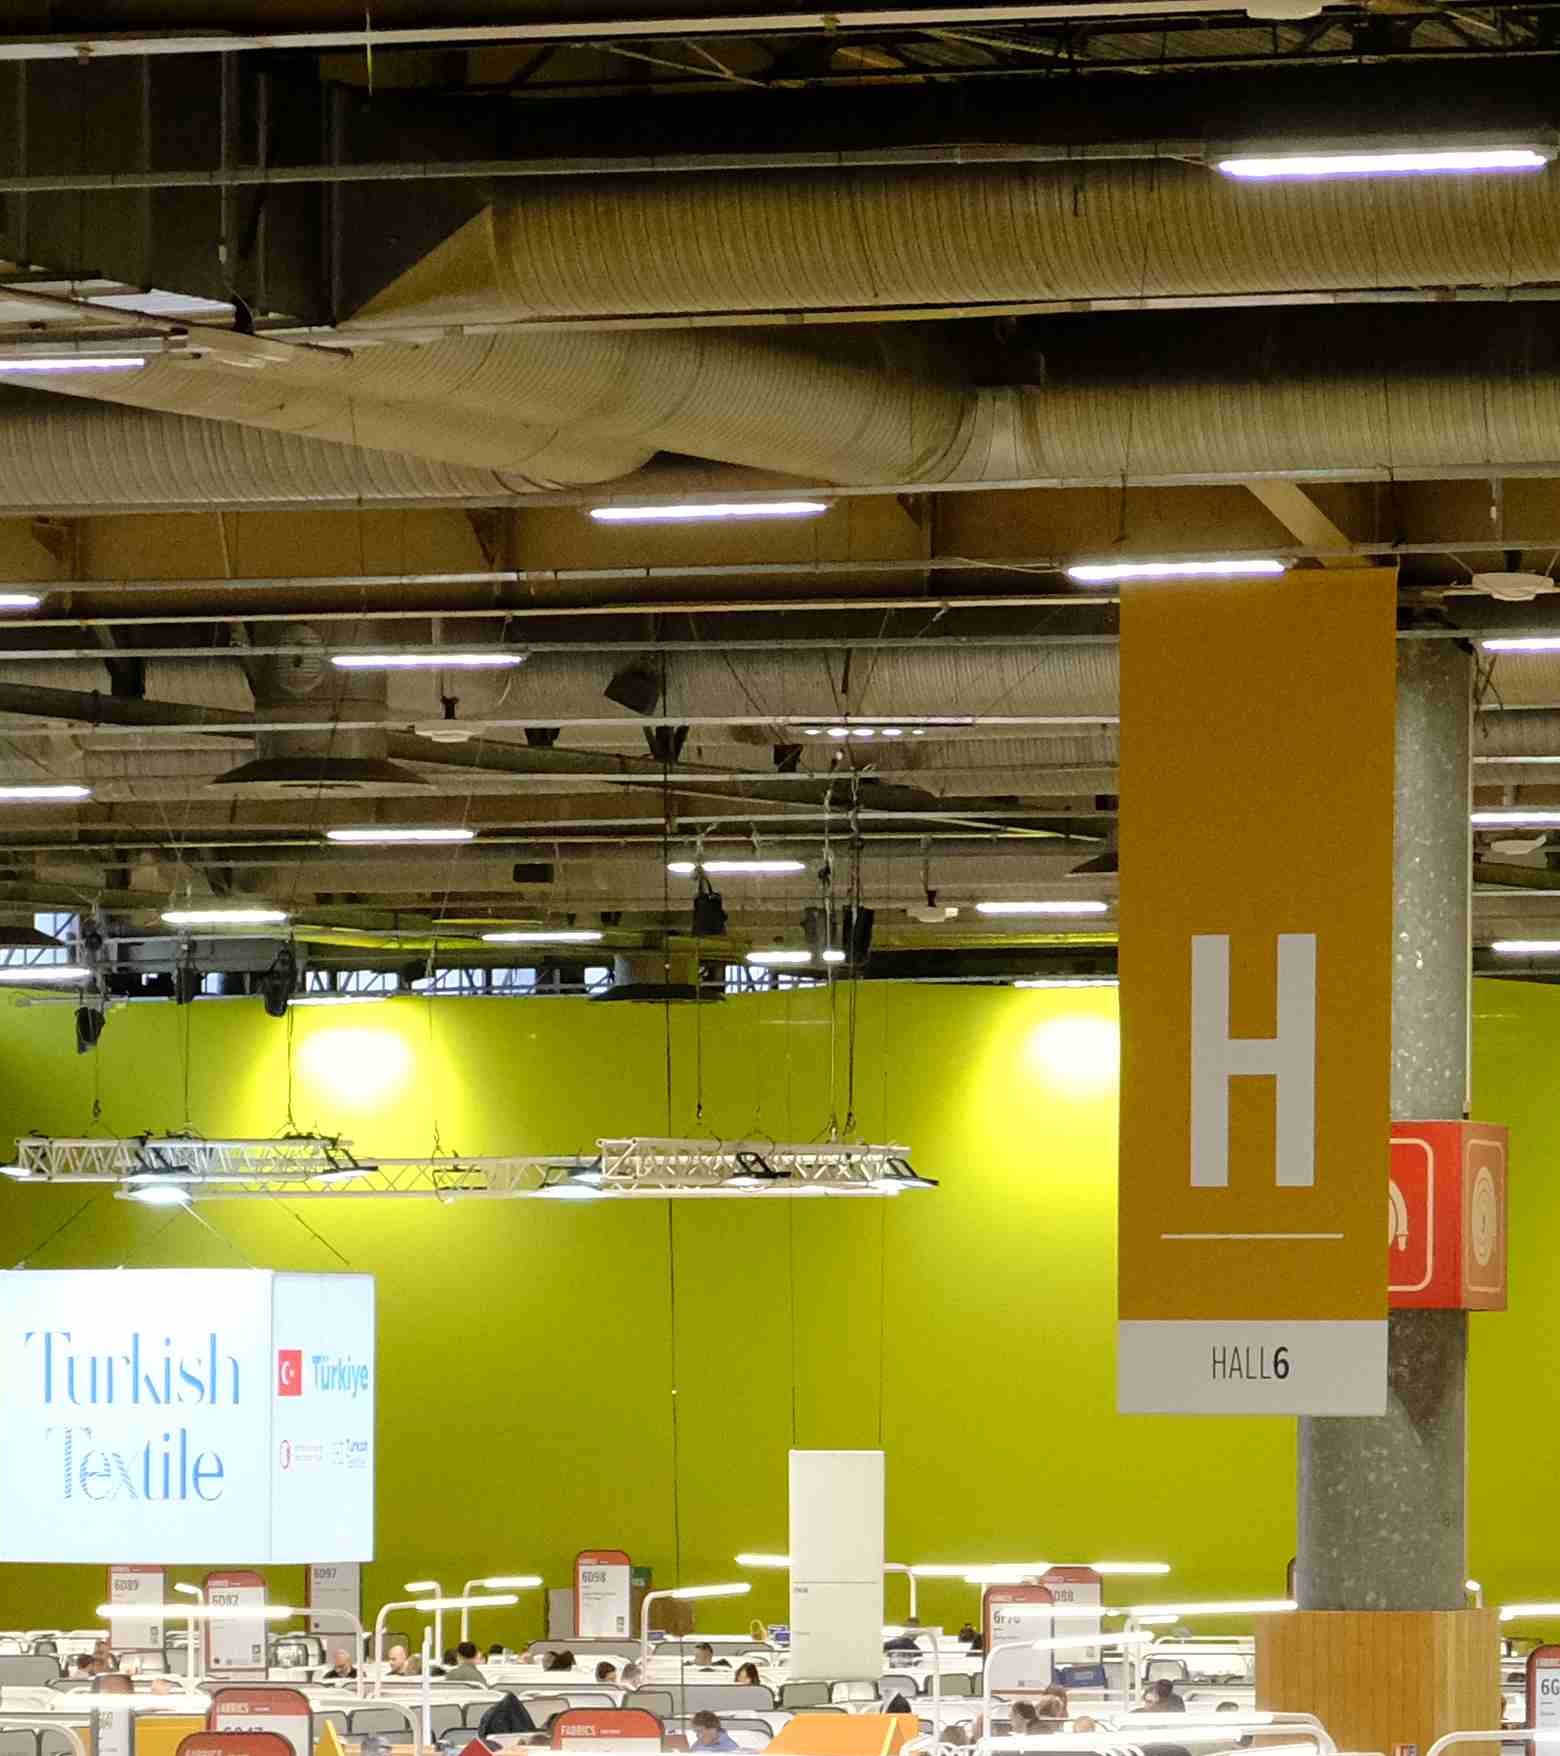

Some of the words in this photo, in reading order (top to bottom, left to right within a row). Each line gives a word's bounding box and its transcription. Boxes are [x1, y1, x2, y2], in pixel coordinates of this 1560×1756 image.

[1191, 934, 1316, 1187] H
[24, 1331, 241, 1405] Turkish
[45, 1426, 225, 1502] Textile
